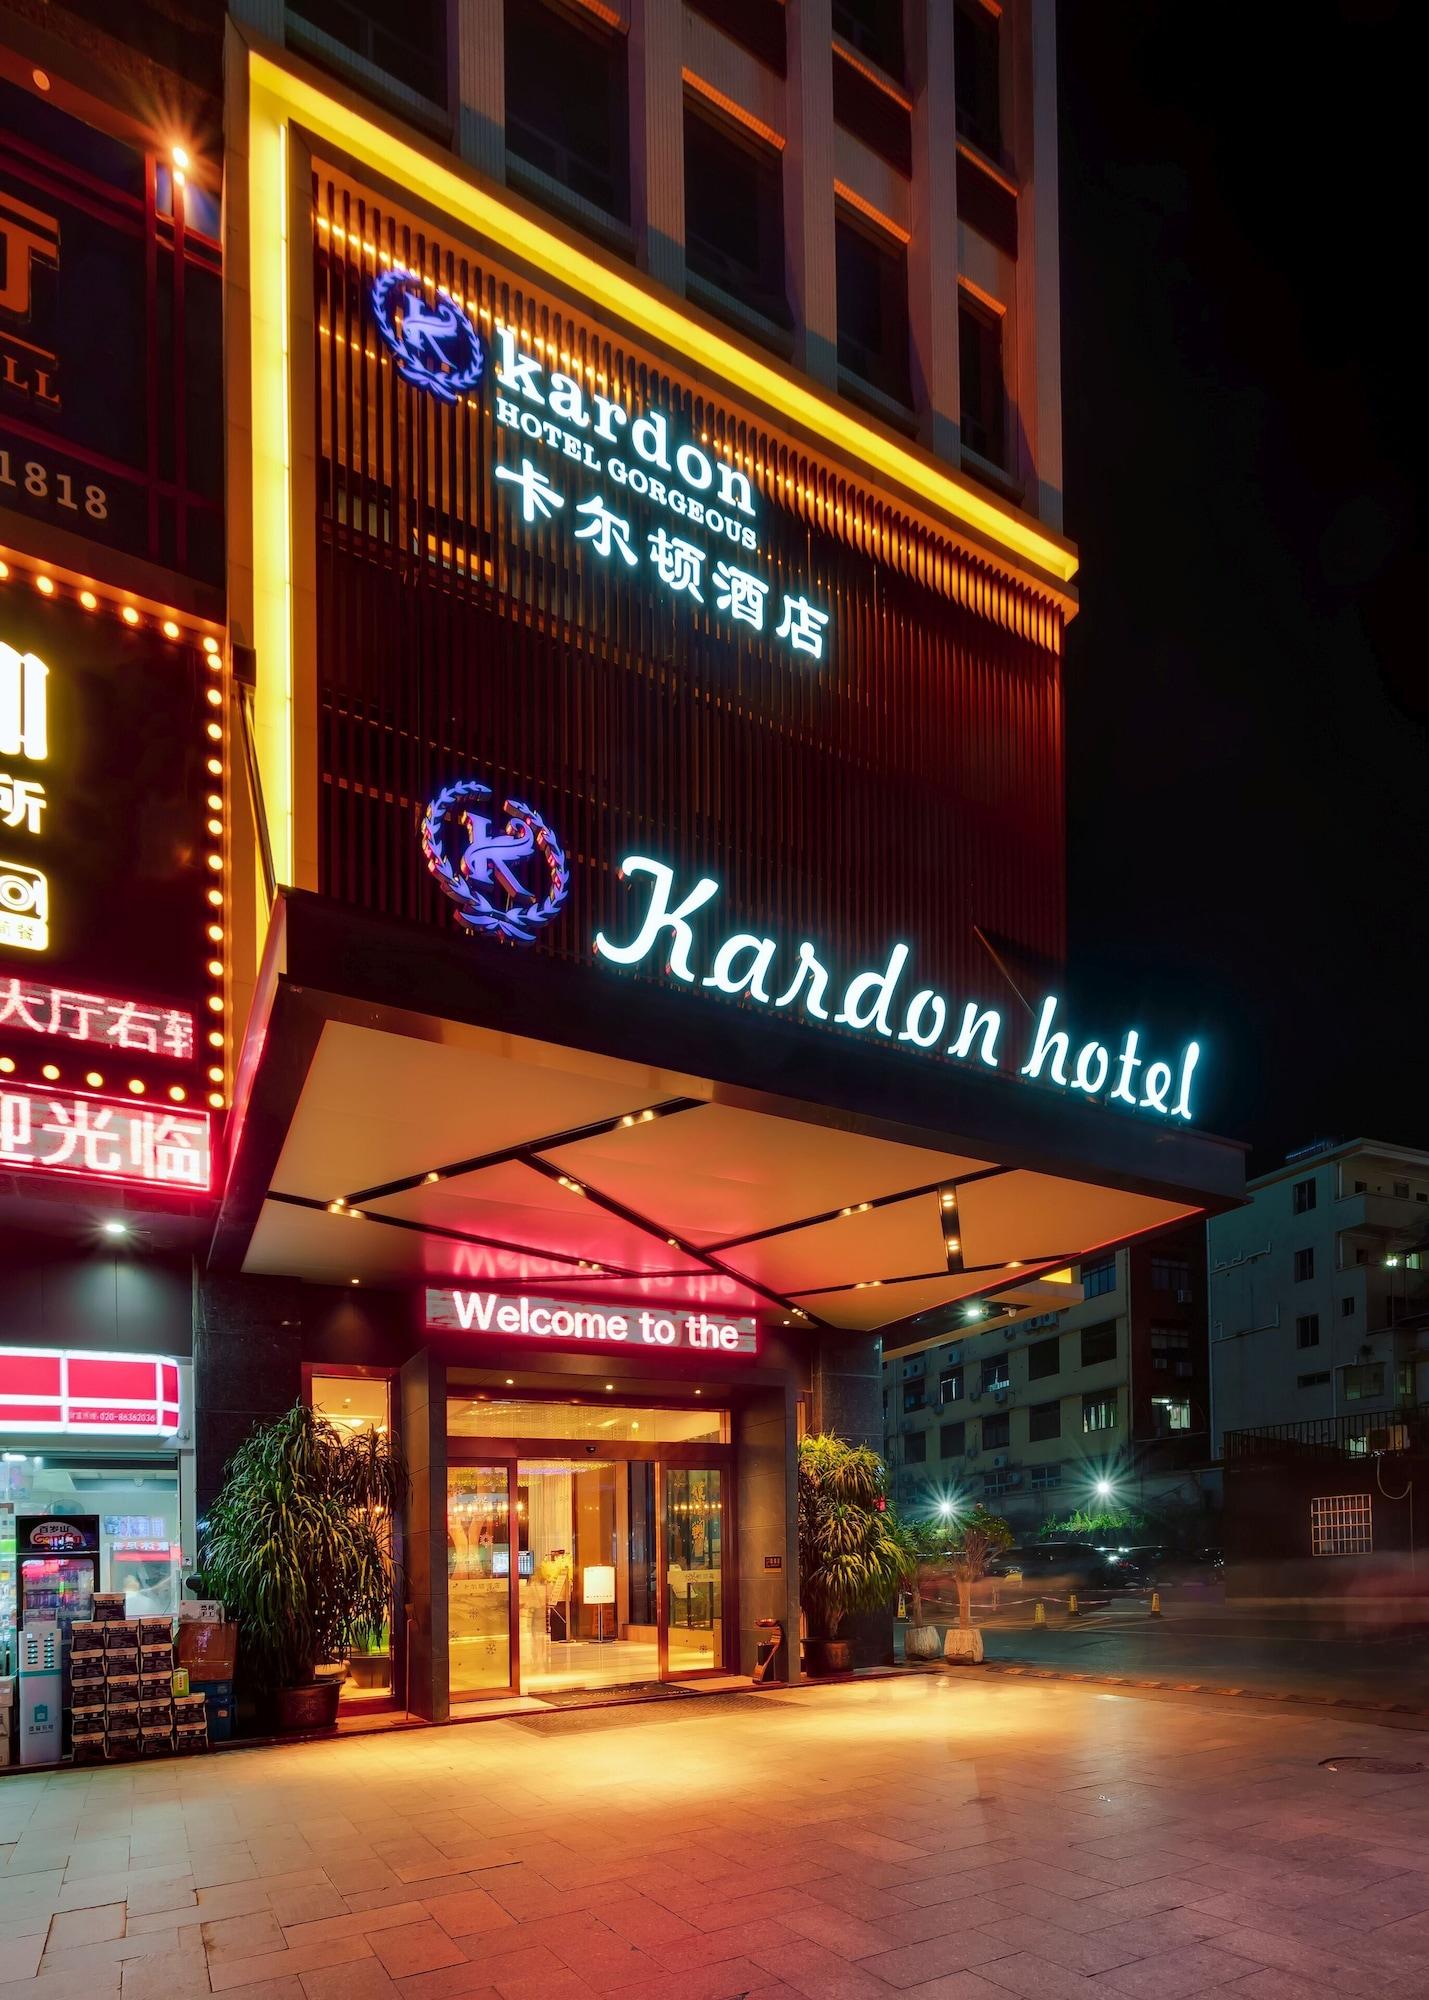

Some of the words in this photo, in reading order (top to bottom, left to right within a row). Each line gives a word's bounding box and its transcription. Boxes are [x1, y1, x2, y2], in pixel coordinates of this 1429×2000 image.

[0, 450, 107, 519] 1818
[496, 326, 757, 517] kardon
[496, 397, 601, 472] HOTEL
[607, 456, 758, 551] GORGEOUS
[495, 458, 829, 659] 卡尔顿酒店
[596, 855, 1002, 1068] Kardon
[1021, 996, 1201, 1121] hotel
[452, 1290, 629, 1341] Welcome
[638, 1311, 676, 1345] to
[685, 1314, 739, 1350] the
